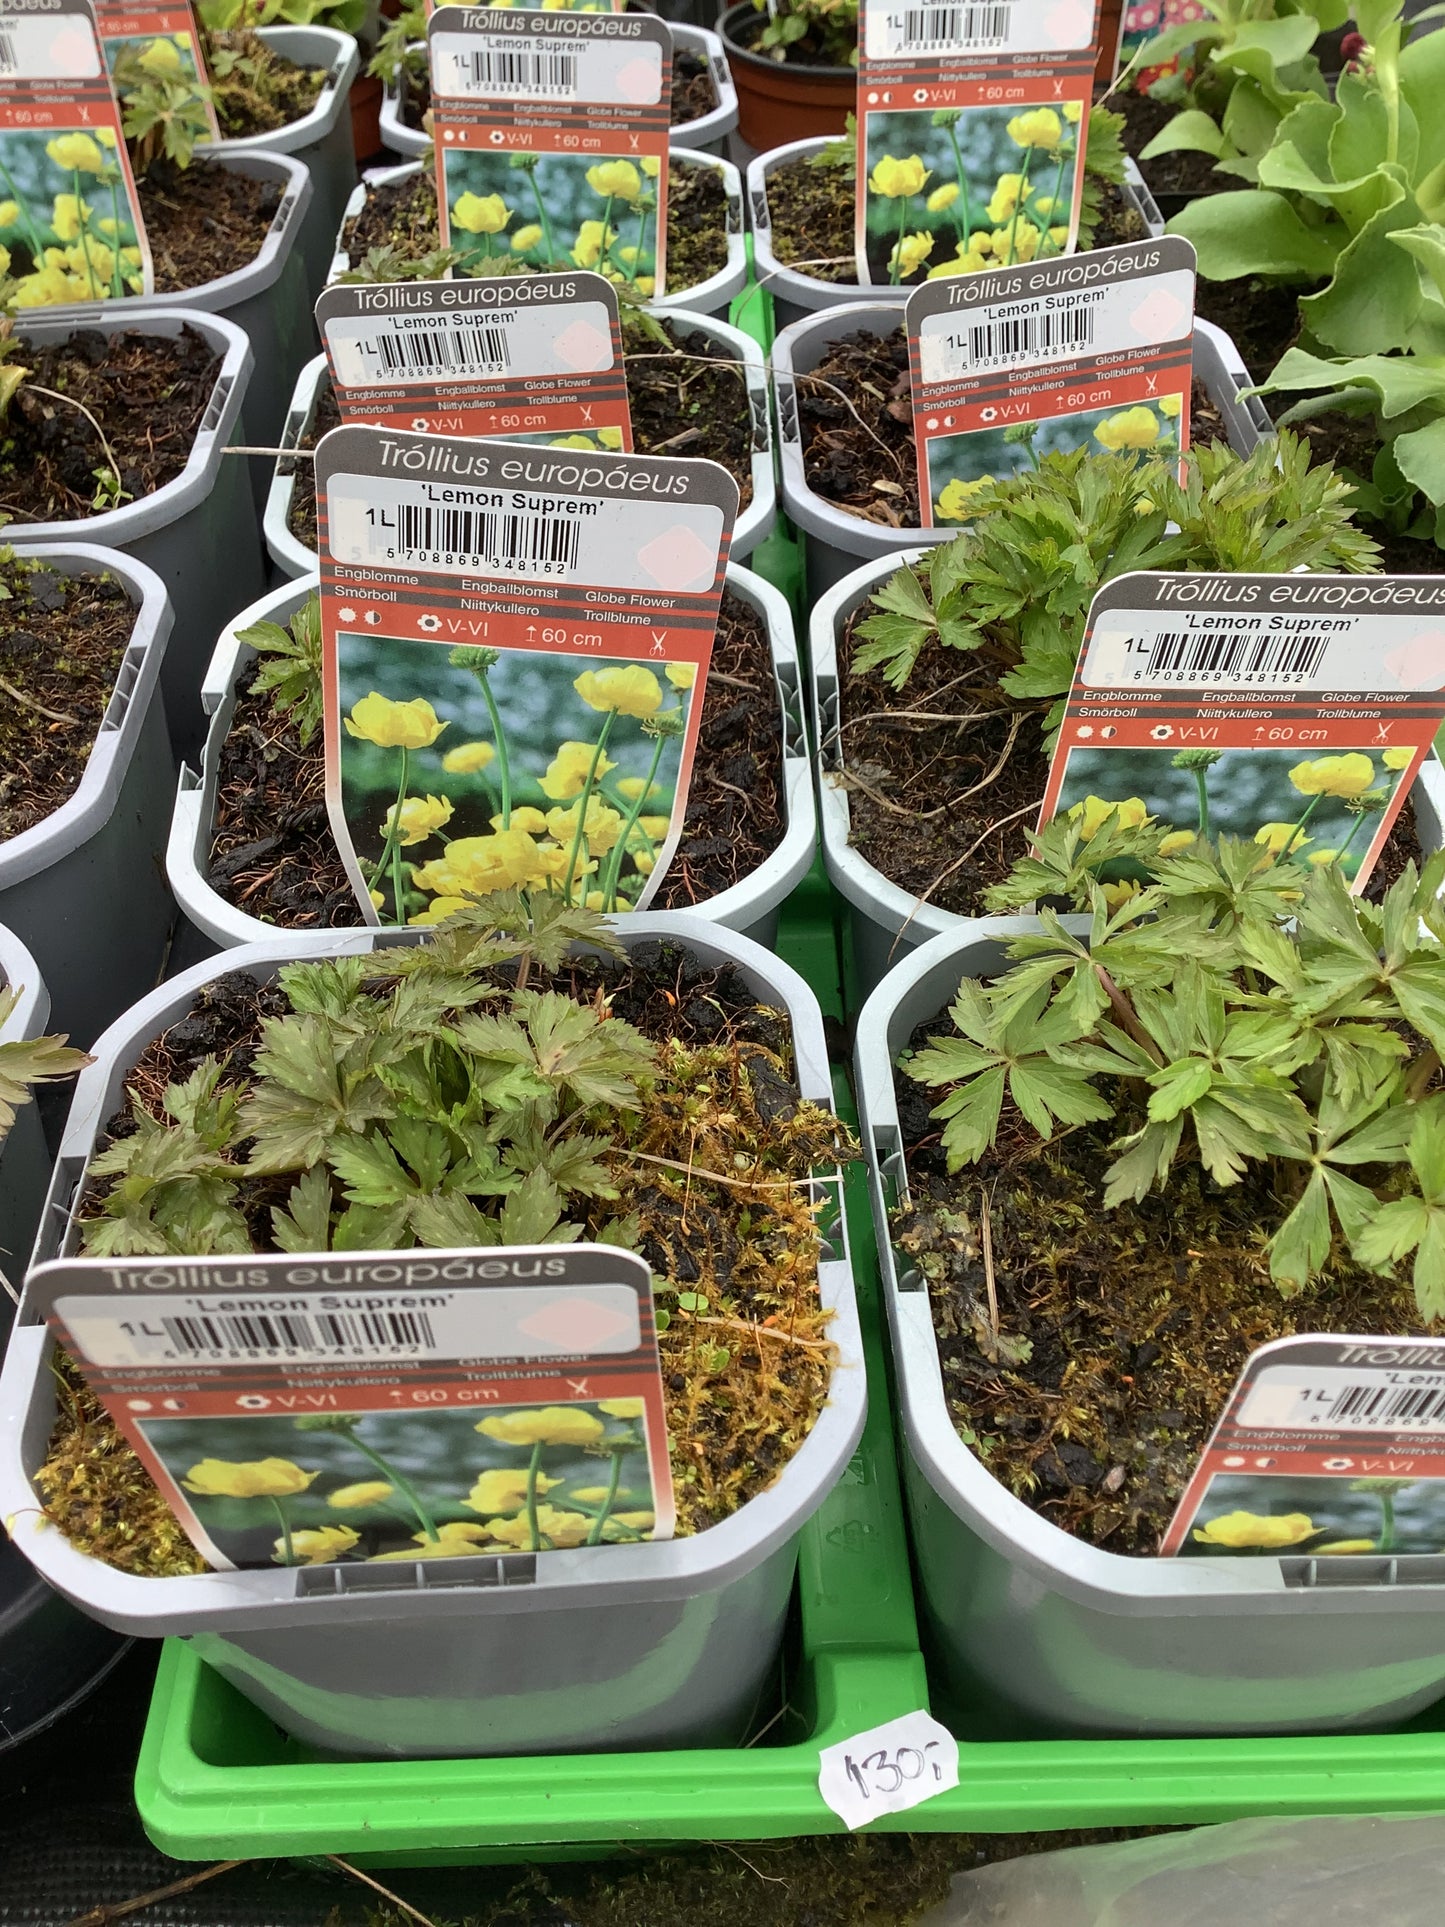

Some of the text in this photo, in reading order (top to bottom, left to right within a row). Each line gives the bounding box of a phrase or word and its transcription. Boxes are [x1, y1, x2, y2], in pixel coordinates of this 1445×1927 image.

[461, 11, 641, 37] Tróllius europáeus
[887, 16, 903, 28] 1L
[453, 56, 470, 67] 1L
[931, 90, 956, 101] V-VI
[987, 87, 1024, 98] 60 cm
[507, 133, 532, 145] V-VI
[564, 136, 600, 147] 60 cm
[947, 251, 1161, 305] Tróllius europáeus
[354, 281, 576, 309] Tróllius europáeus
[946, 334, 967, 348] 1L
[356, 342, 377, 354] 1L
[1096, 347, 1161, 366] Globe Flower
[1009, 362, 1077, 381] Engballblomst
[1096, 365, 1144, 380] Trollblume
[436, 383, 505, 396] Engballblomst
[524, 378, 591, 390] Globe Flower
[922, 380, 980, 397] Engblomme
[1009, 380, 1065, 397] Niittykullero
[346, 388, 405, 400] Engblomme
[527, 394, 577, 405] Trollblume
[1068, 390, 1111, 407] 60 cm
[349, 404, 394, 415] Smörboll
[438, 400, 496, 411] Niittykullero
[923, 397, 966, 411] Smörboll
[1000, 402, 1029, 418] V-VI
[432, 418, 463, 431] V-VI
[502, 415, 546, 427] 60 cm
[379, 441, 689, 494] Tróllius europáeus
[366, 508, 395, 527] 1L
[334, 566, 419, 586] Engblomme
[335, 586, 397, 602] Smörboll
[461, 579, 558, 599] Engballblomst
[1155, 579, 1445, 608] Tróllius europáeus
[586, 591, 675, 609] Globe Flower
[461, 599, 540, 618] Niittykullero
[584, 609, 651, 626] Trollblume
[447, 619, 488, 637] V-VI
[542, 627, 602, 646] 60 cm
[1083, 691, 1162, 703] Engblomme
[1202, 692, 1296, 704] Engballblomst
[1321, 692, 1410, 703] Globe Flower
[1079, 707, 1137, 717] Smörboll
[1197, 708, 1273, 720] Niittykullero
[1316, 708, 1381, 718] Trollblume
[1179, 727, 1219, 740] V-VI
[1269, 727, 1327, 740] 60 cm
[103, 1257, 566, 1289] Tróllius europáeus
[1386, 1372, 1445, 1385] 'Lem
[276, 1394, 337, 1408] V-VI
[412, 1388, 500, 1402] 60 cm
[1233, 1430, 1341, 1441] Engblomme
[1226, 1442, 1306, 1453] Smörboll
[1362, 1460, 1414, 1471] V-VI
